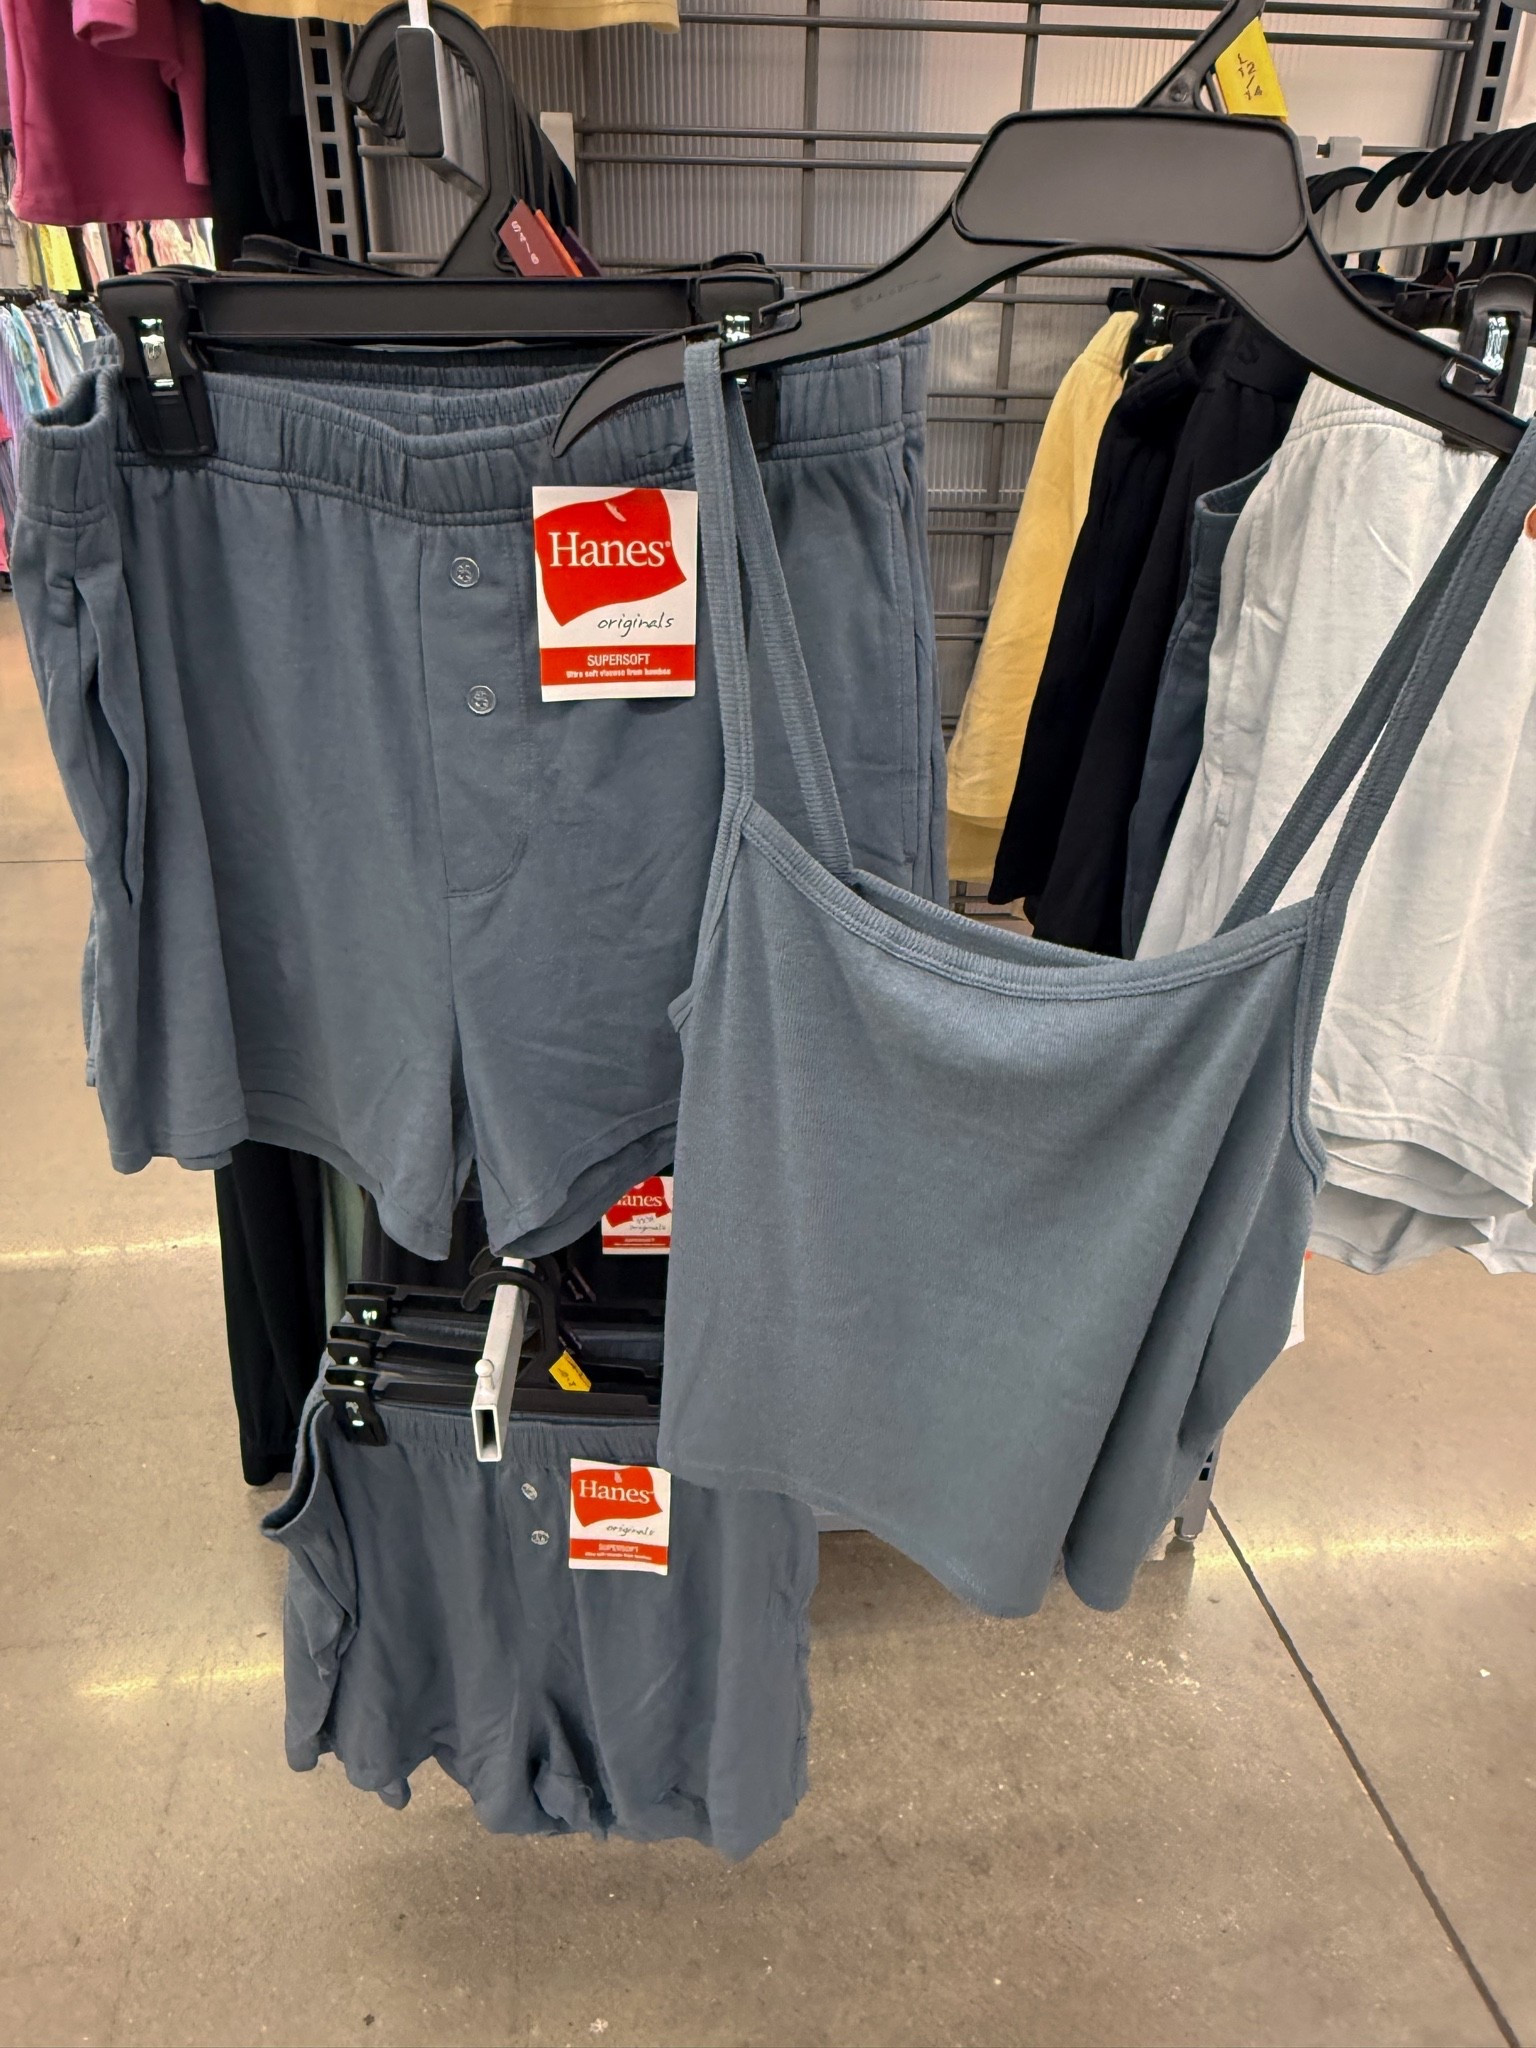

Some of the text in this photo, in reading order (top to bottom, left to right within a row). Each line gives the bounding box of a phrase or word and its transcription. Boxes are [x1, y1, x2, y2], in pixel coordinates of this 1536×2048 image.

[548, 531, 666, 567] Hanes
[597, 612, 675, 638] originals
[587, 653, 650, 667] SUPERSOFT
[616, 1194, 663, 1207] anes
[579, 1479, 651, 1505] Hanes
